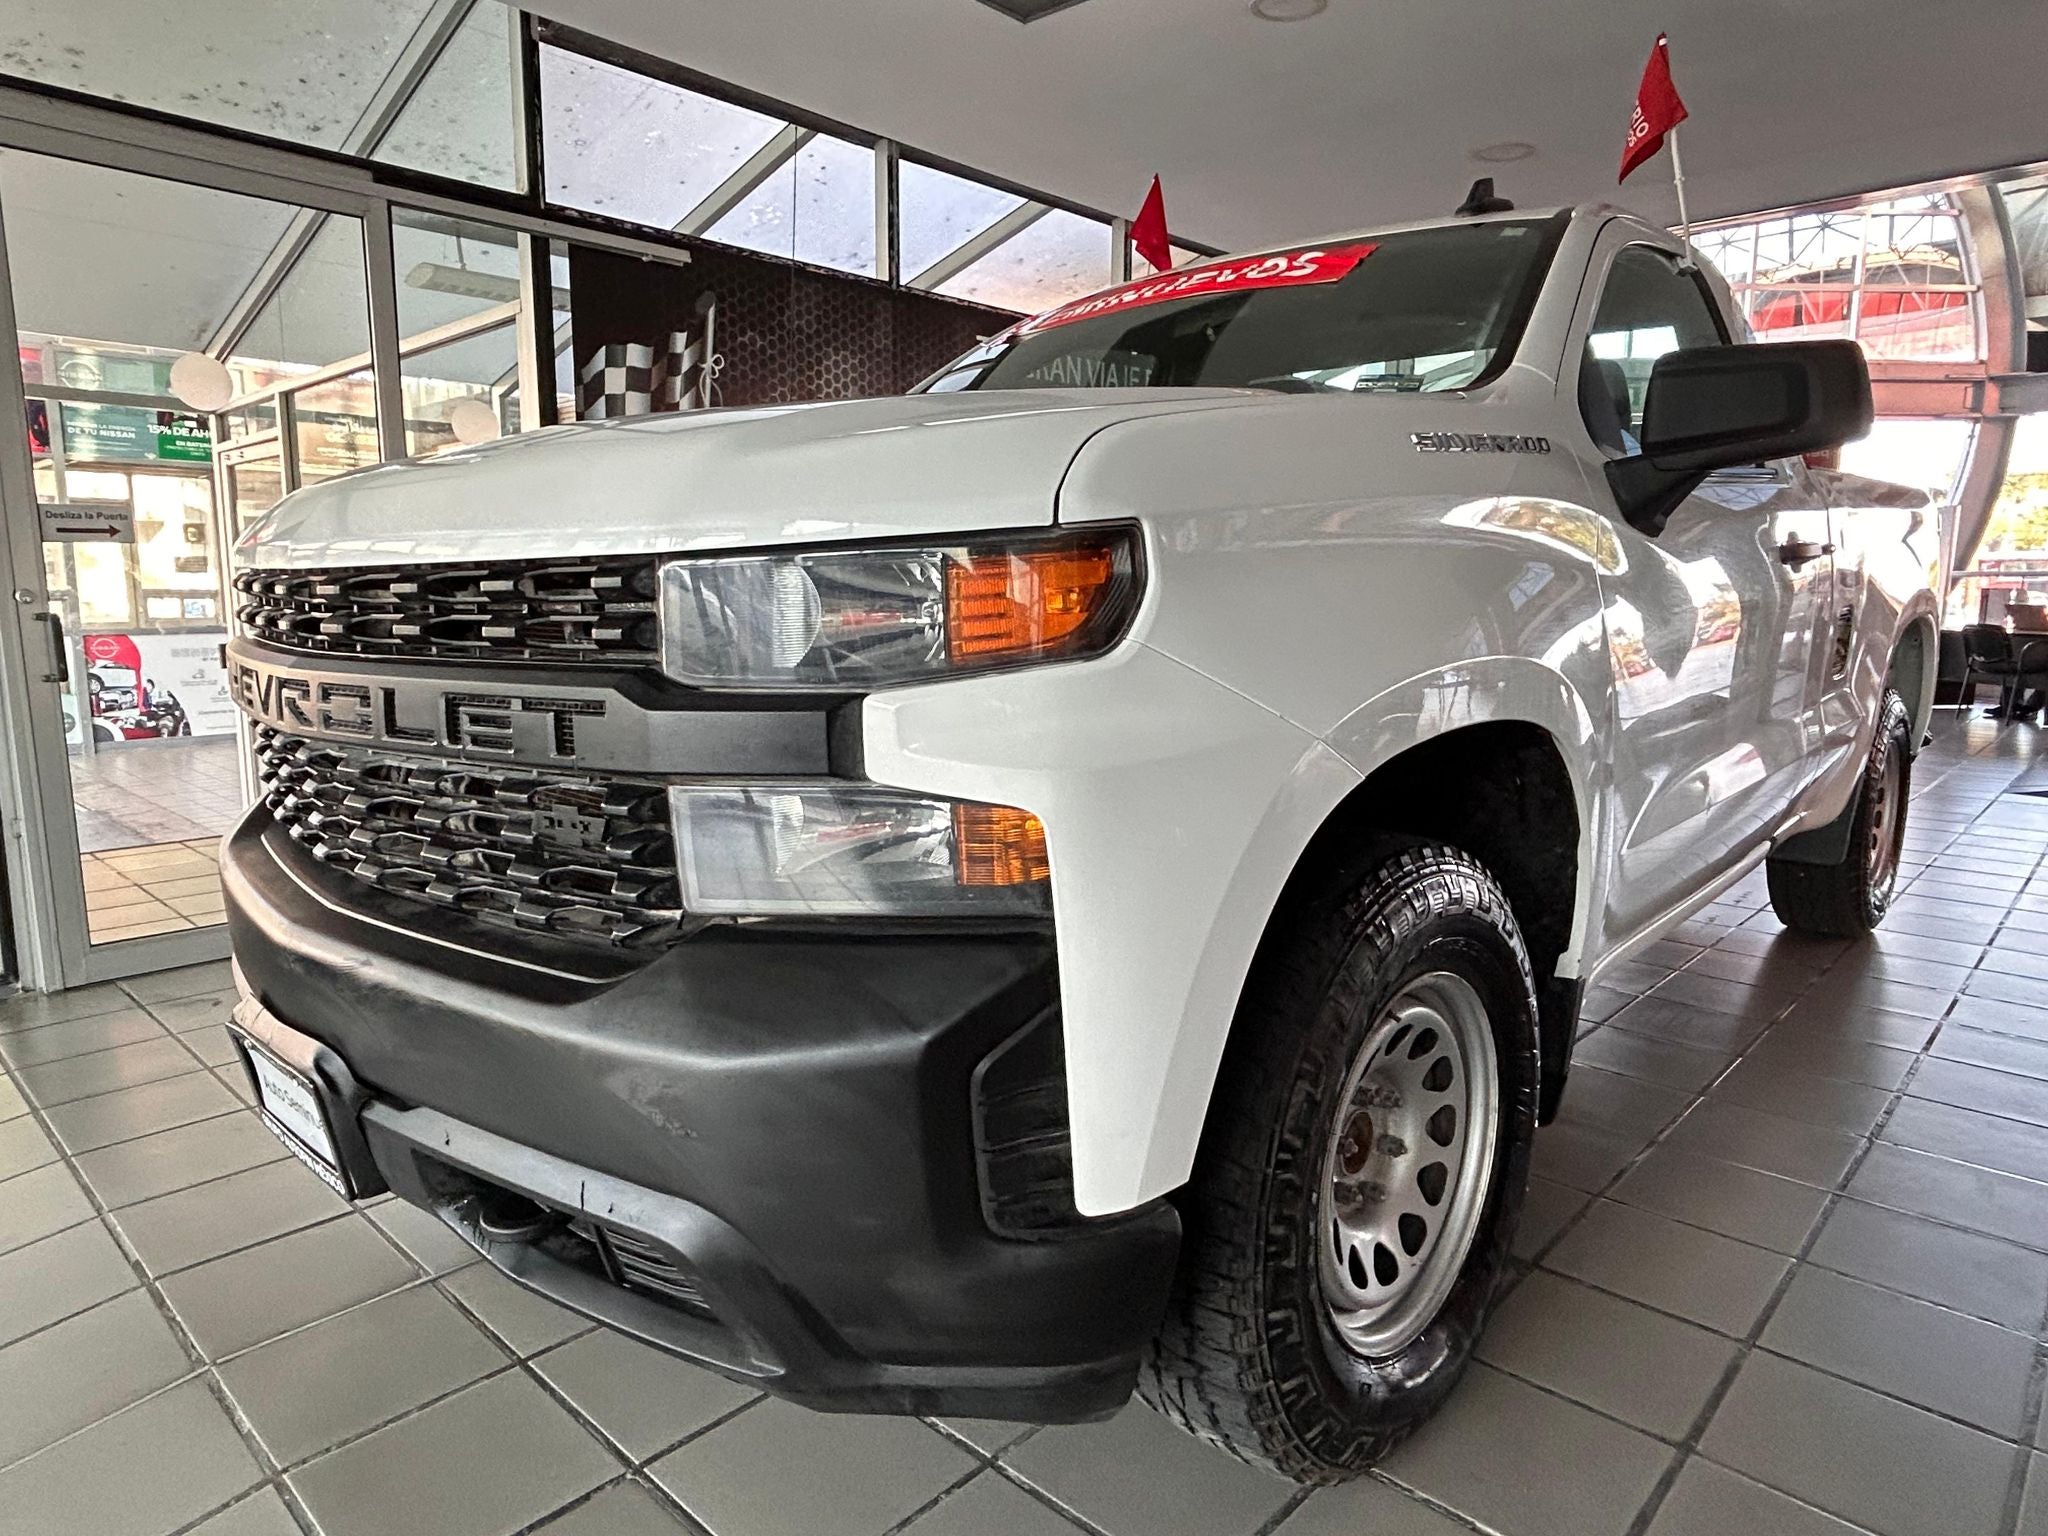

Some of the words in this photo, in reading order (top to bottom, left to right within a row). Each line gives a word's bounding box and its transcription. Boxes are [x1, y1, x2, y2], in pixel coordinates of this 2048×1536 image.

[1632, 104, 1649, 138] RIO
[147, 424, 172, 435] 15%
[173, 427, 190, 437] DE
[191, 428, 210, 438] AH
[45, 510, 82, 519] Desliza
[84, 511, 94, 520] la
[96, 512, 128, 521] Puerta
